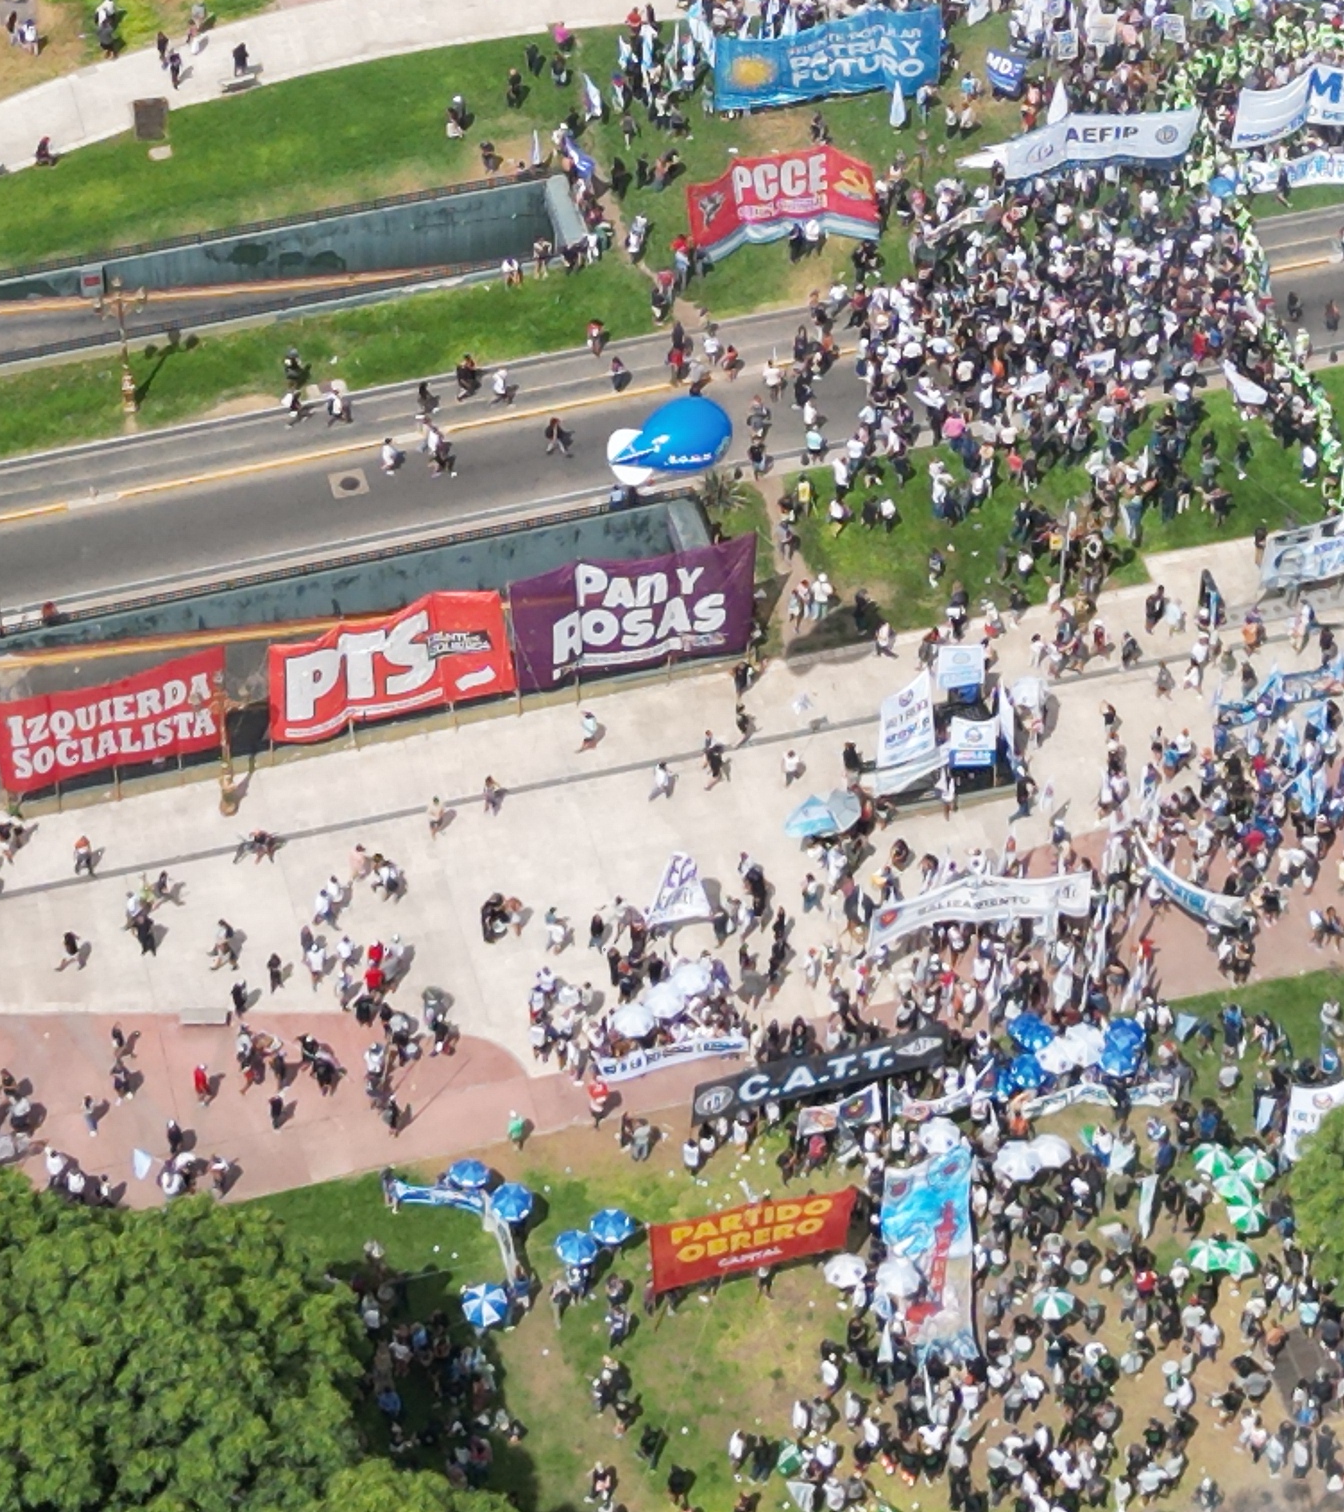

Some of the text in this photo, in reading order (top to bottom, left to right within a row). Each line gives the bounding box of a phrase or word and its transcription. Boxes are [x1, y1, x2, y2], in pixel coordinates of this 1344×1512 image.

[789, 37, 922, 69] PATRIA Y
[792, 55, 925, 88] FUTURO
[1066, 126, 1139, 144] AEFIP
[731, 153, 828, 204] PCCE
[676, 566, 705, 595] Y
[552, 593, 727, 665] ROSAS
[285, 610, 437, 722] PTS
[6, 672, 212, 748] IZQUIERDA
[11, 707, 217, 780] SOCIALISTA
[739, 1045, 895, 1102] C.A.T.T.
[670, 1198, 833, 1246] PARTIDO
[675, 1217, 825, 1263] OBRERO
